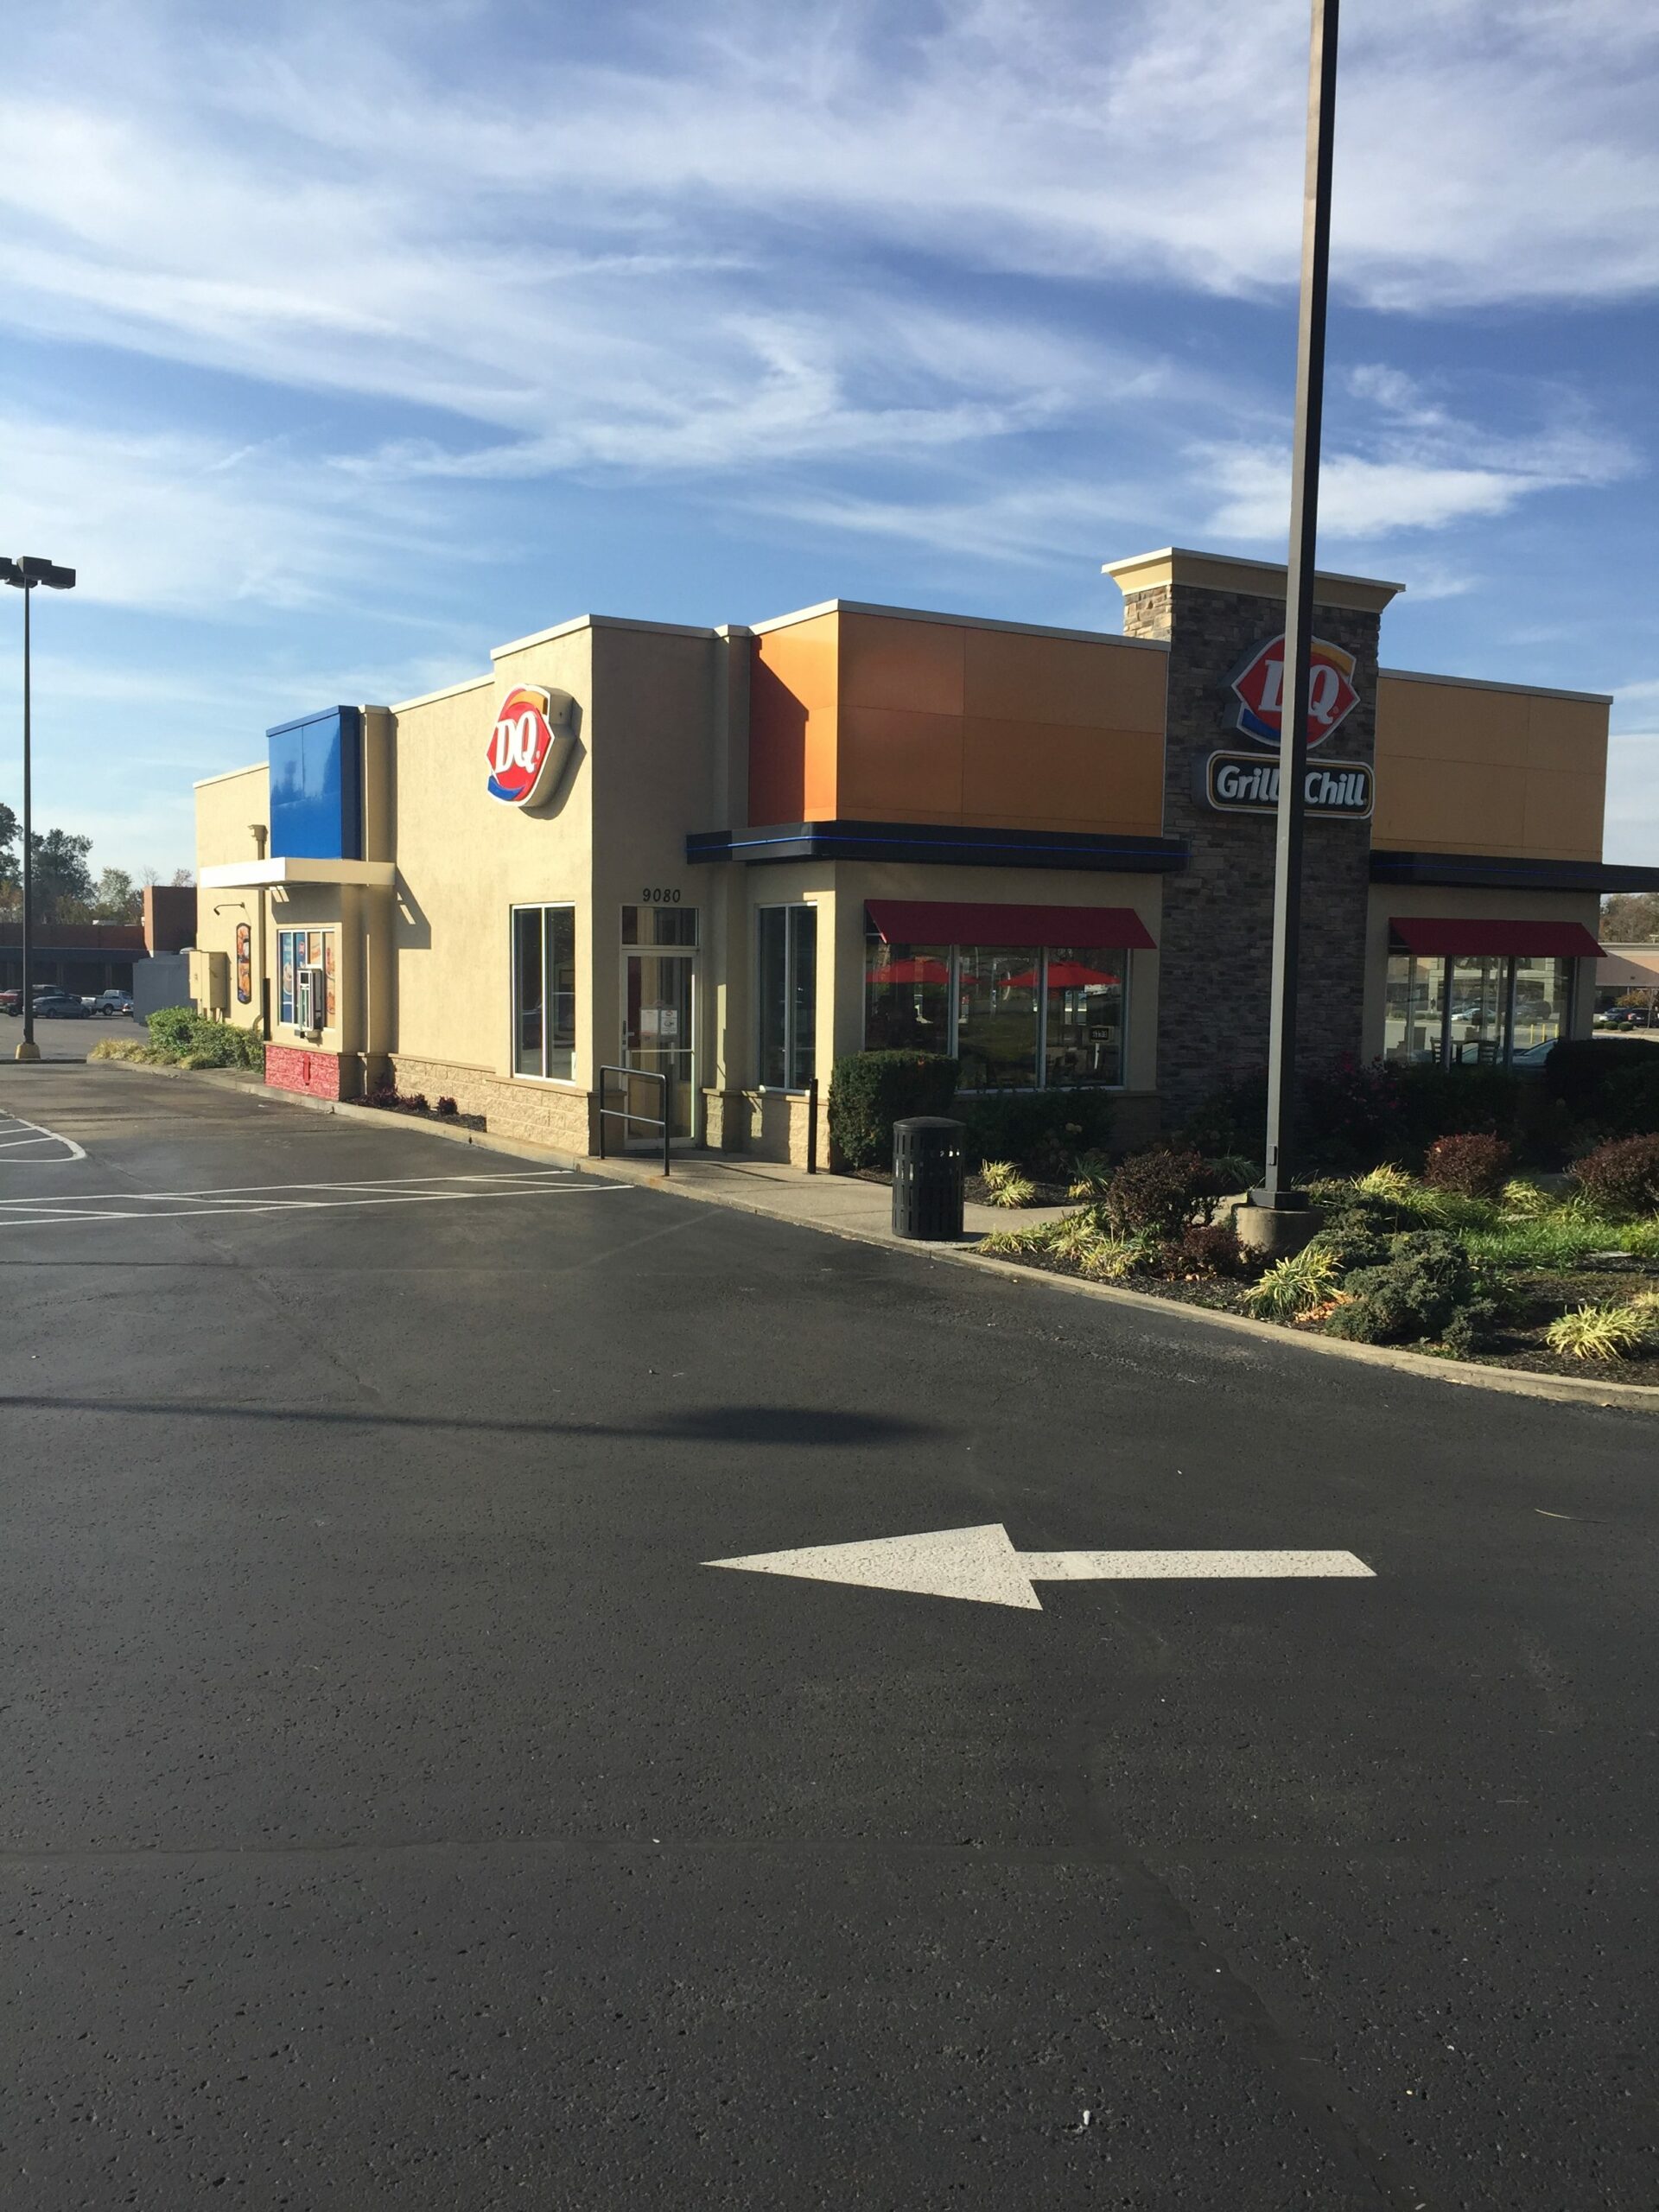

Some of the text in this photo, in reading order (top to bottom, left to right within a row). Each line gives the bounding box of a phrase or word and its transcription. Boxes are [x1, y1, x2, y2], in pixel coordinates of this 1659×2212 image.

[495, 709, 538, 773] DQ
[1217, 765, 1365, 806] Grill Chill
[642, 887, 682, 903] 9080
